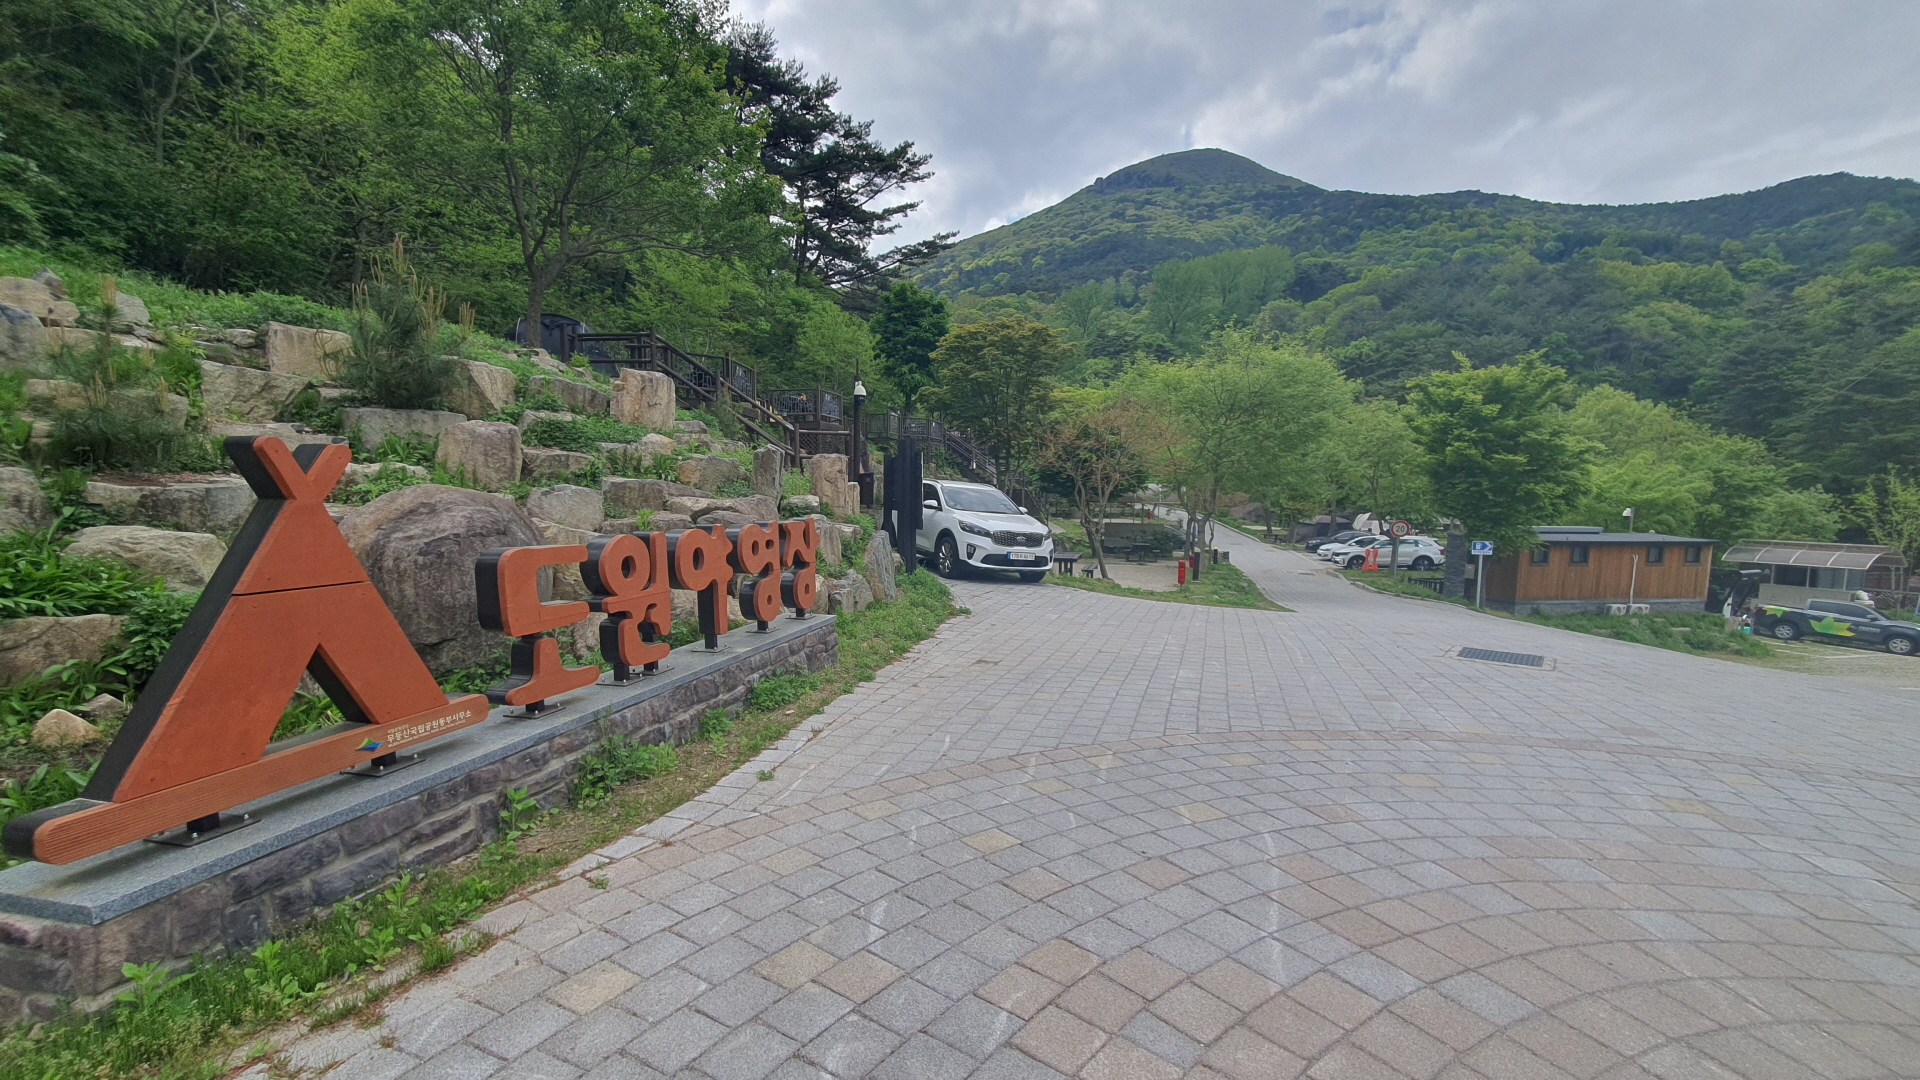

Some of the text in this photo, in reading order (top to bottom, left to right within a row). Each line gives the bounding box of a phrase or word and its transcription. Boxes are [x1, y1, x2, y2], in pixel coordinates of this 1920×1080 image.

[1395, 525, 1405, 533] 20
[497, 517, 820, 706] 도원야영장
[387, 710, 472, 742] 무등산국립공원동부사무소
